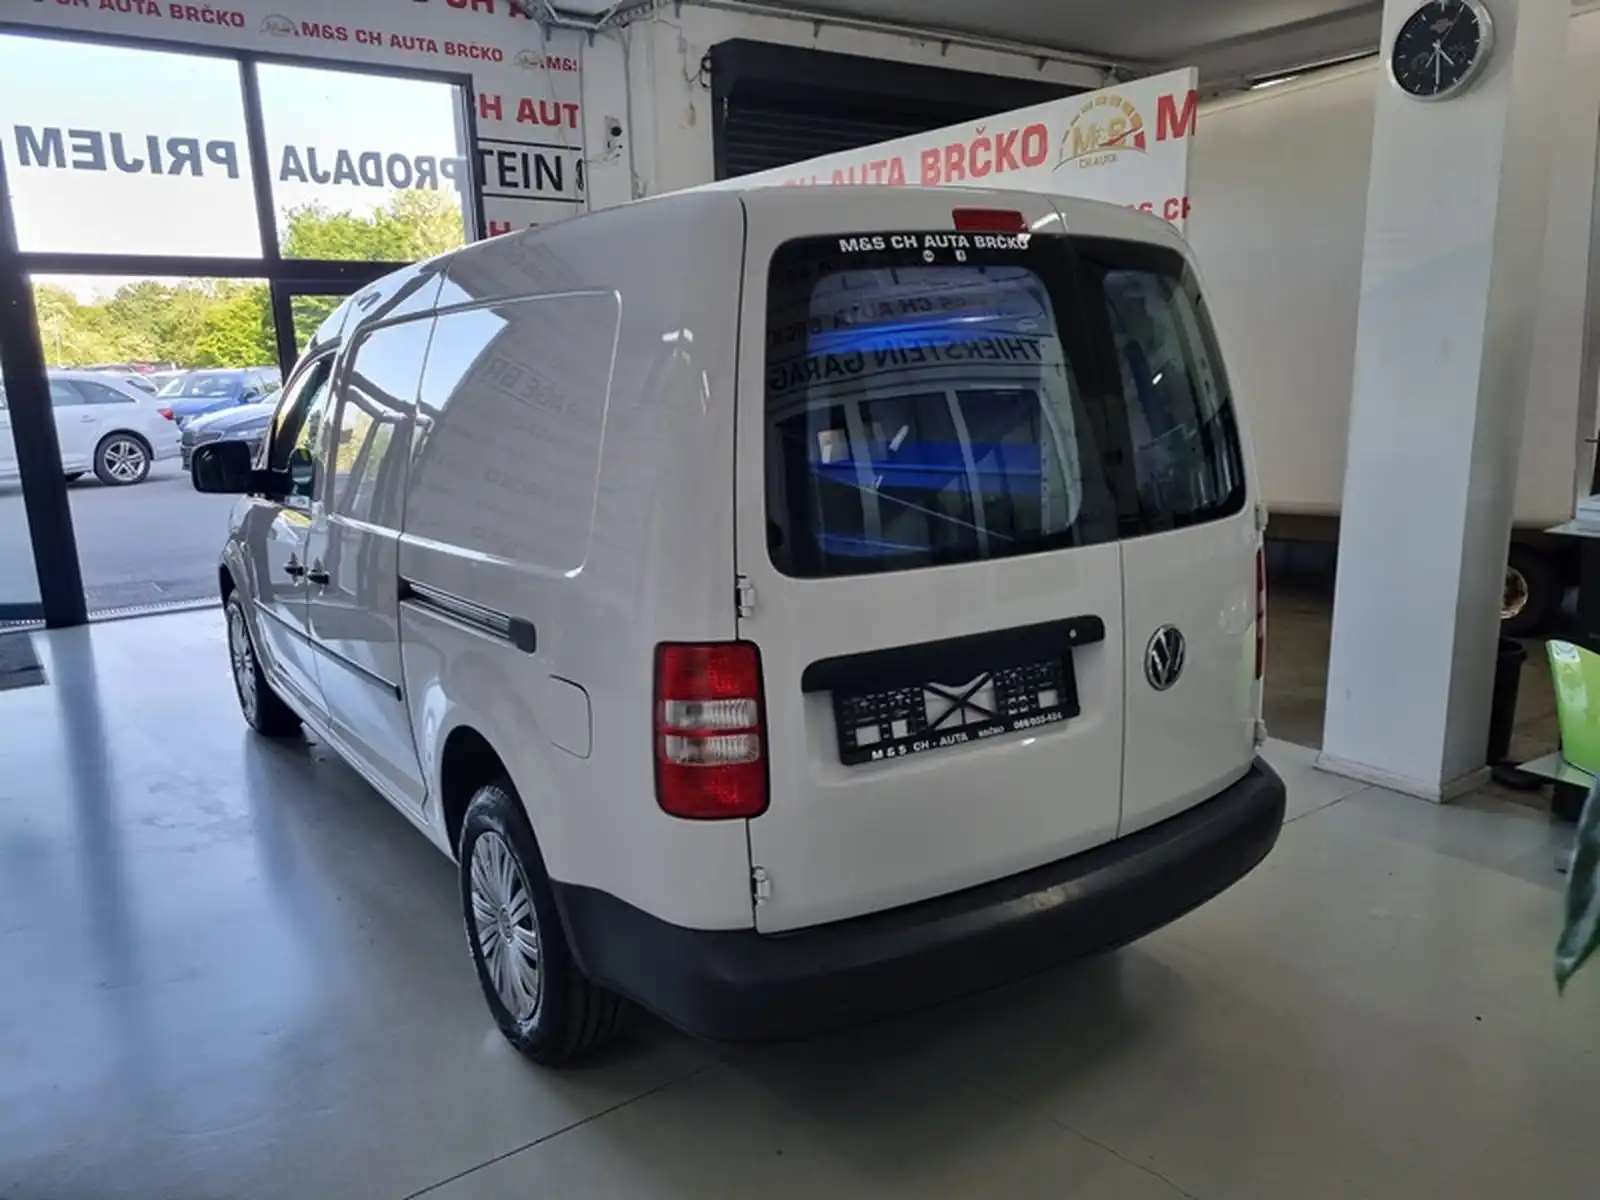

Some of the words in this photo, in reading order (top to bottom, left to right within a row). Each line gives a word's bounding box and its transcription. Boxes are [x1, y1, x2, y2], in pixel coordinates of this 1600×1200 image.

[301, 21, 349, 42] M&S
[355, 28, 383, 46] CH
[389, 34, 439, 54] AUTA
[479, 92, 503, 121] H
[516, 97, 580, 129] AUT
[478, 148, 563, 192] TEIN
[920, 123, 1049, 187] BRČKO
[838, 236, 885, 253] M&S
[890, 234, 918, 249] CH
[923, 234, 970, 249] AUTA
